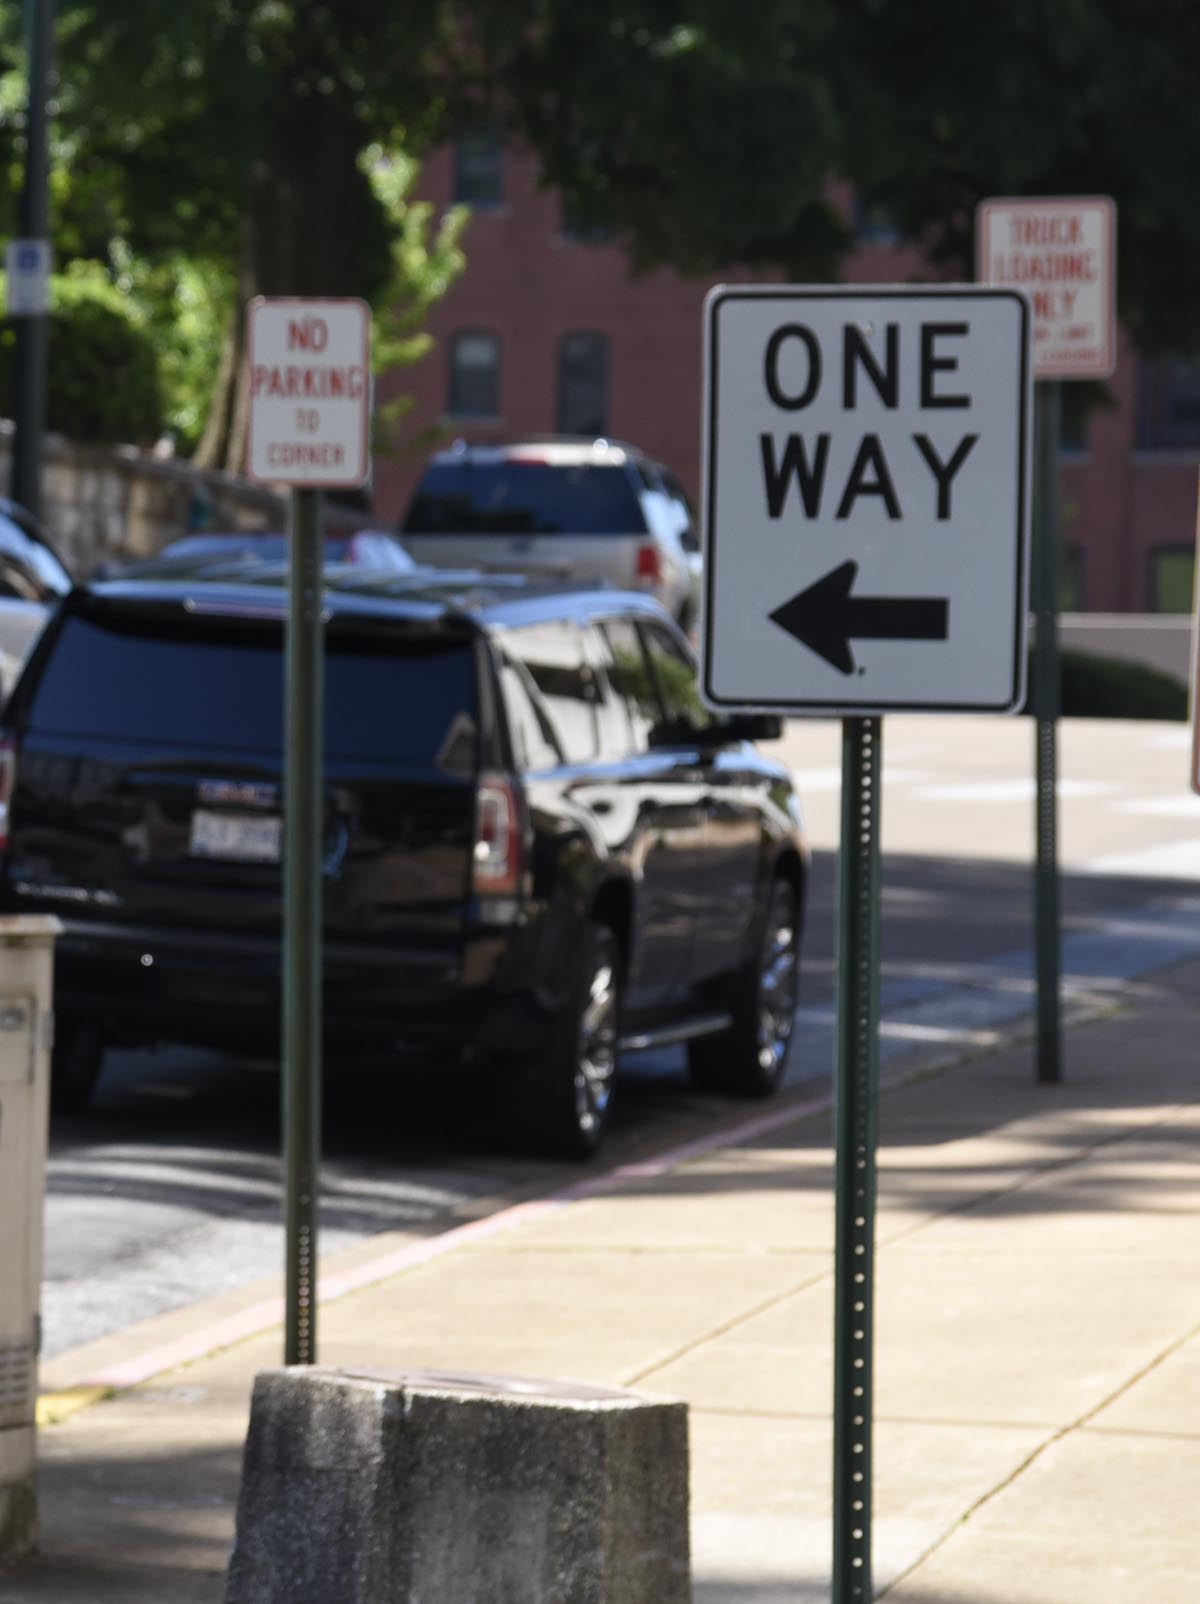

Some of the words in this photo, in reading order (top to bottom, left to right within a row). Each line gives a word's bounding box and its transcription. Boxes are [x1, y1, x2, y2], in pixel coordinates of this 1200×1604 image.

[1010, 216, 1083, 244] TRUCK
[994, 250, 1099, 282] LOADING
[1032, 289, 1078, 320] NLY
[287, 317, 329, 353] NO
[249, 363, 364, 399] PARKING
[764, 322, 971, 412] ONE
[295, 408, 320, 433] TO
[268, 442, 345, 468] CORNER
[760, 433, 978, 521] WAY
